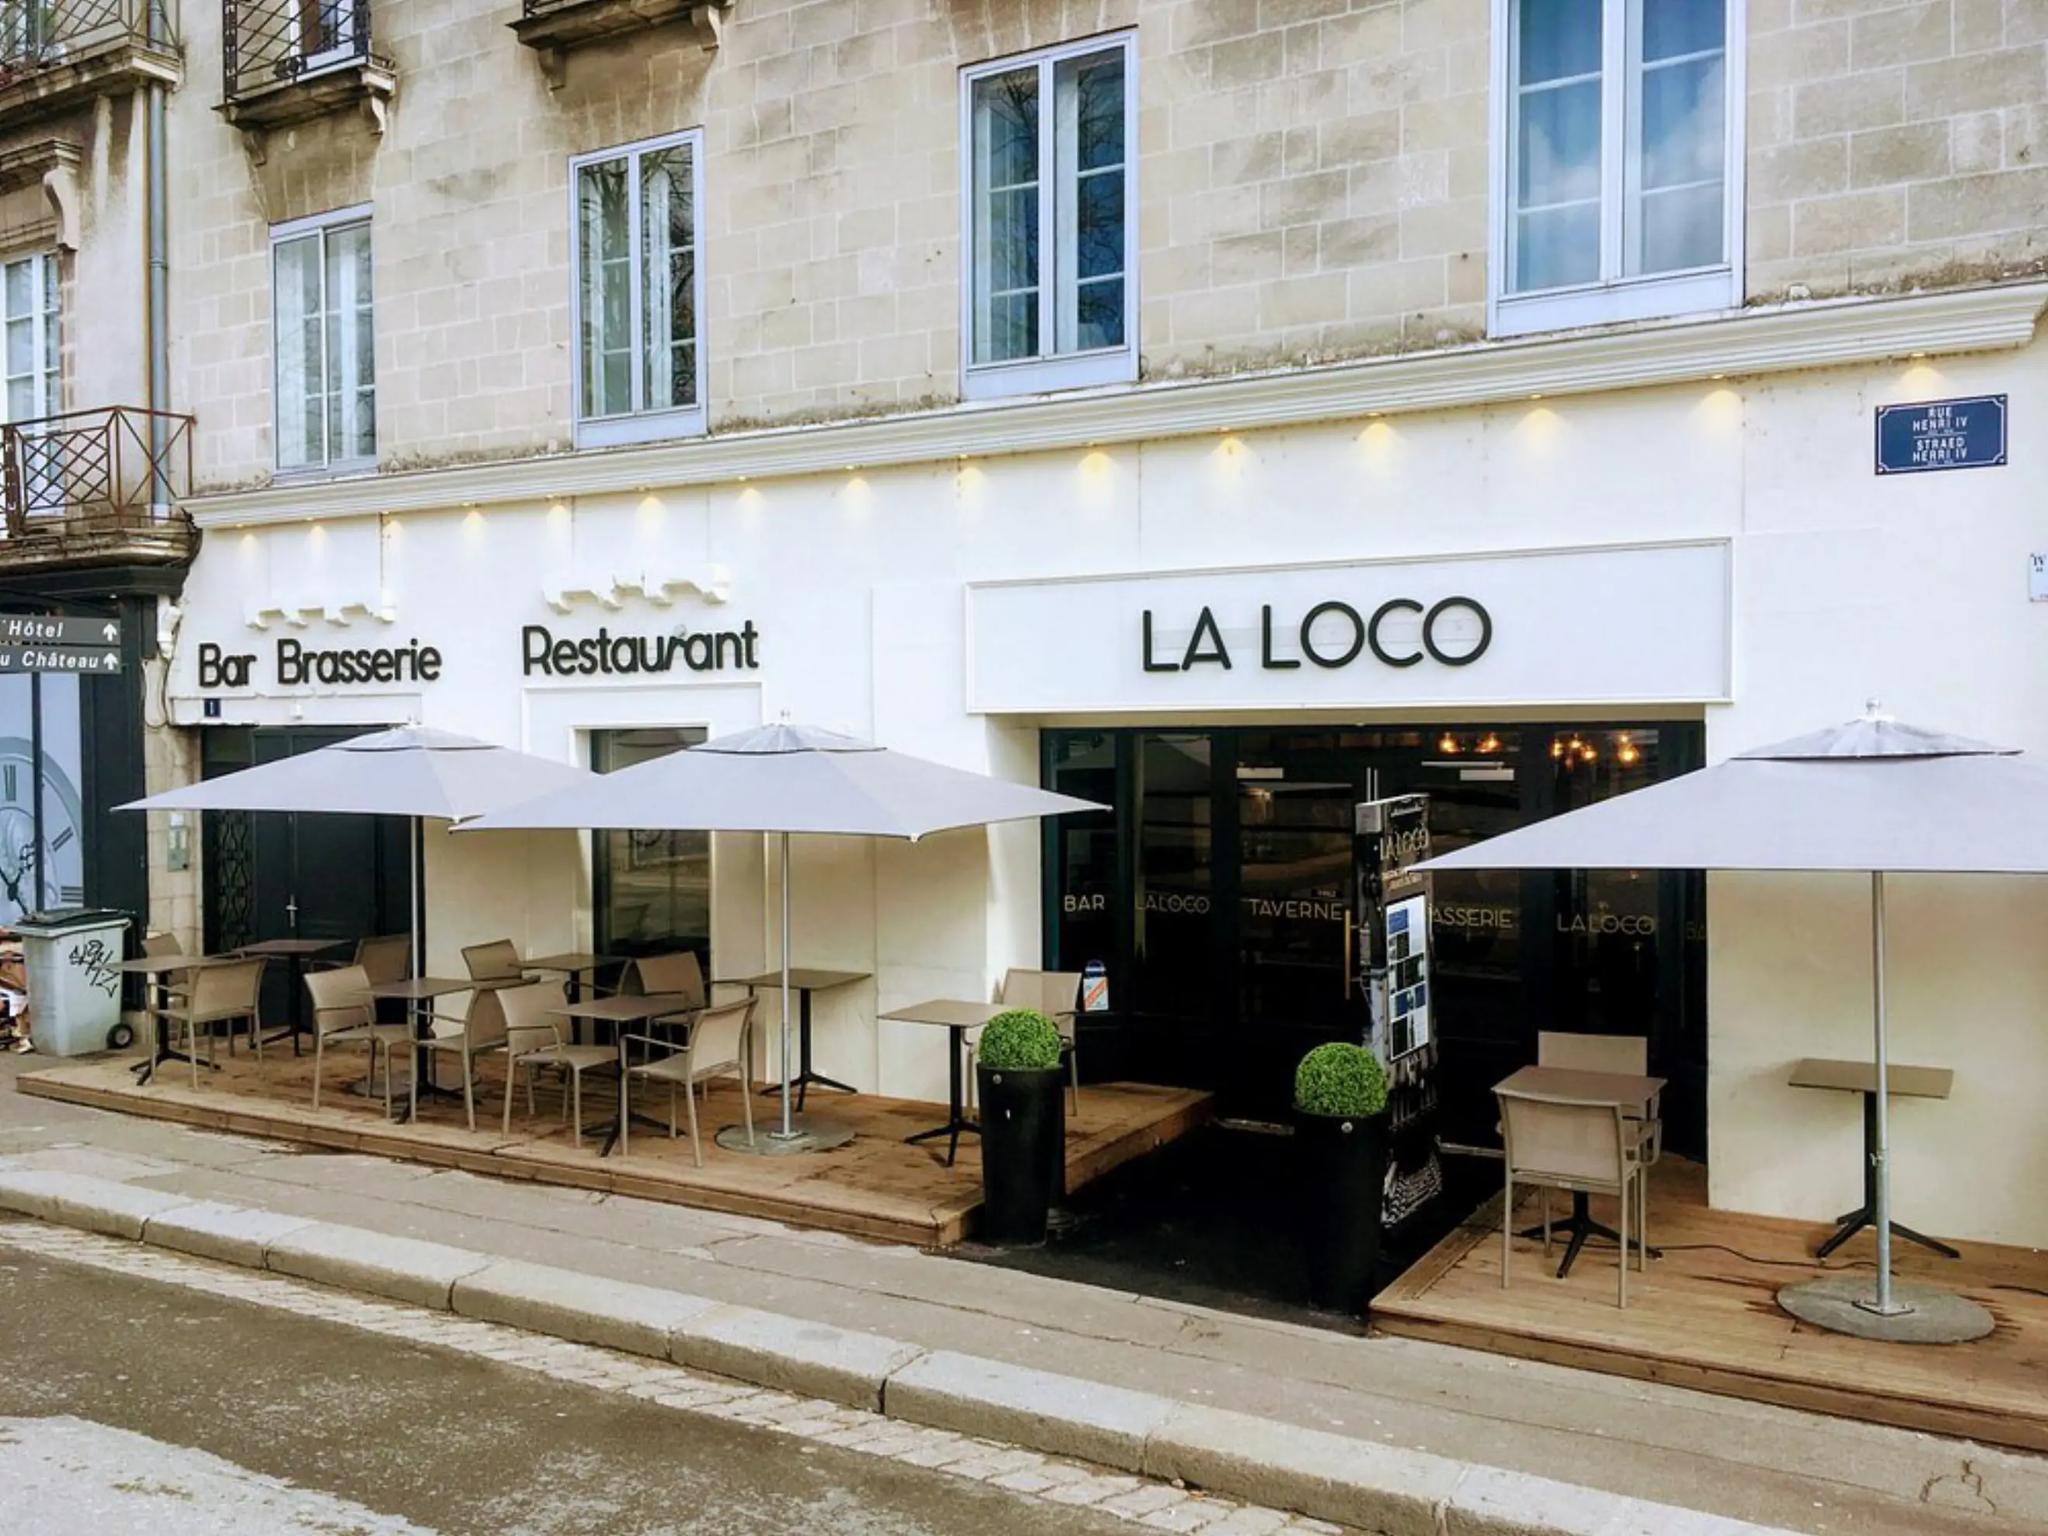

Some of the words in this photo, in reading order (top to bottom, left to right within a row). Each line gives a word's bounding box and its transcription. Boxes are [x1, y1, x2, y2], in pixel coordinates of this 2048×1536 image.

[1928, 406, 1951, 418] RUE
[1912, 418, 1951, 432] HENRI
[1956, 416, 1968, 428] IV
[1916, 436, 1965, 452] STRAED
[1956, 447, 1968, 459] IV
[1143, 606, 1232, 672] LA
[1262, 596, 1493, 669] LOCO
[522, 620, 759, 676] Restaurant
[22, 650, 98, 668] Château
[199, 642, 257, 688] Bar
[277, 638, 442, 684] Brasserie
[1064, 894, 1105, 912] BAR
[1250, 899, 1344, 920] TAVERNE
